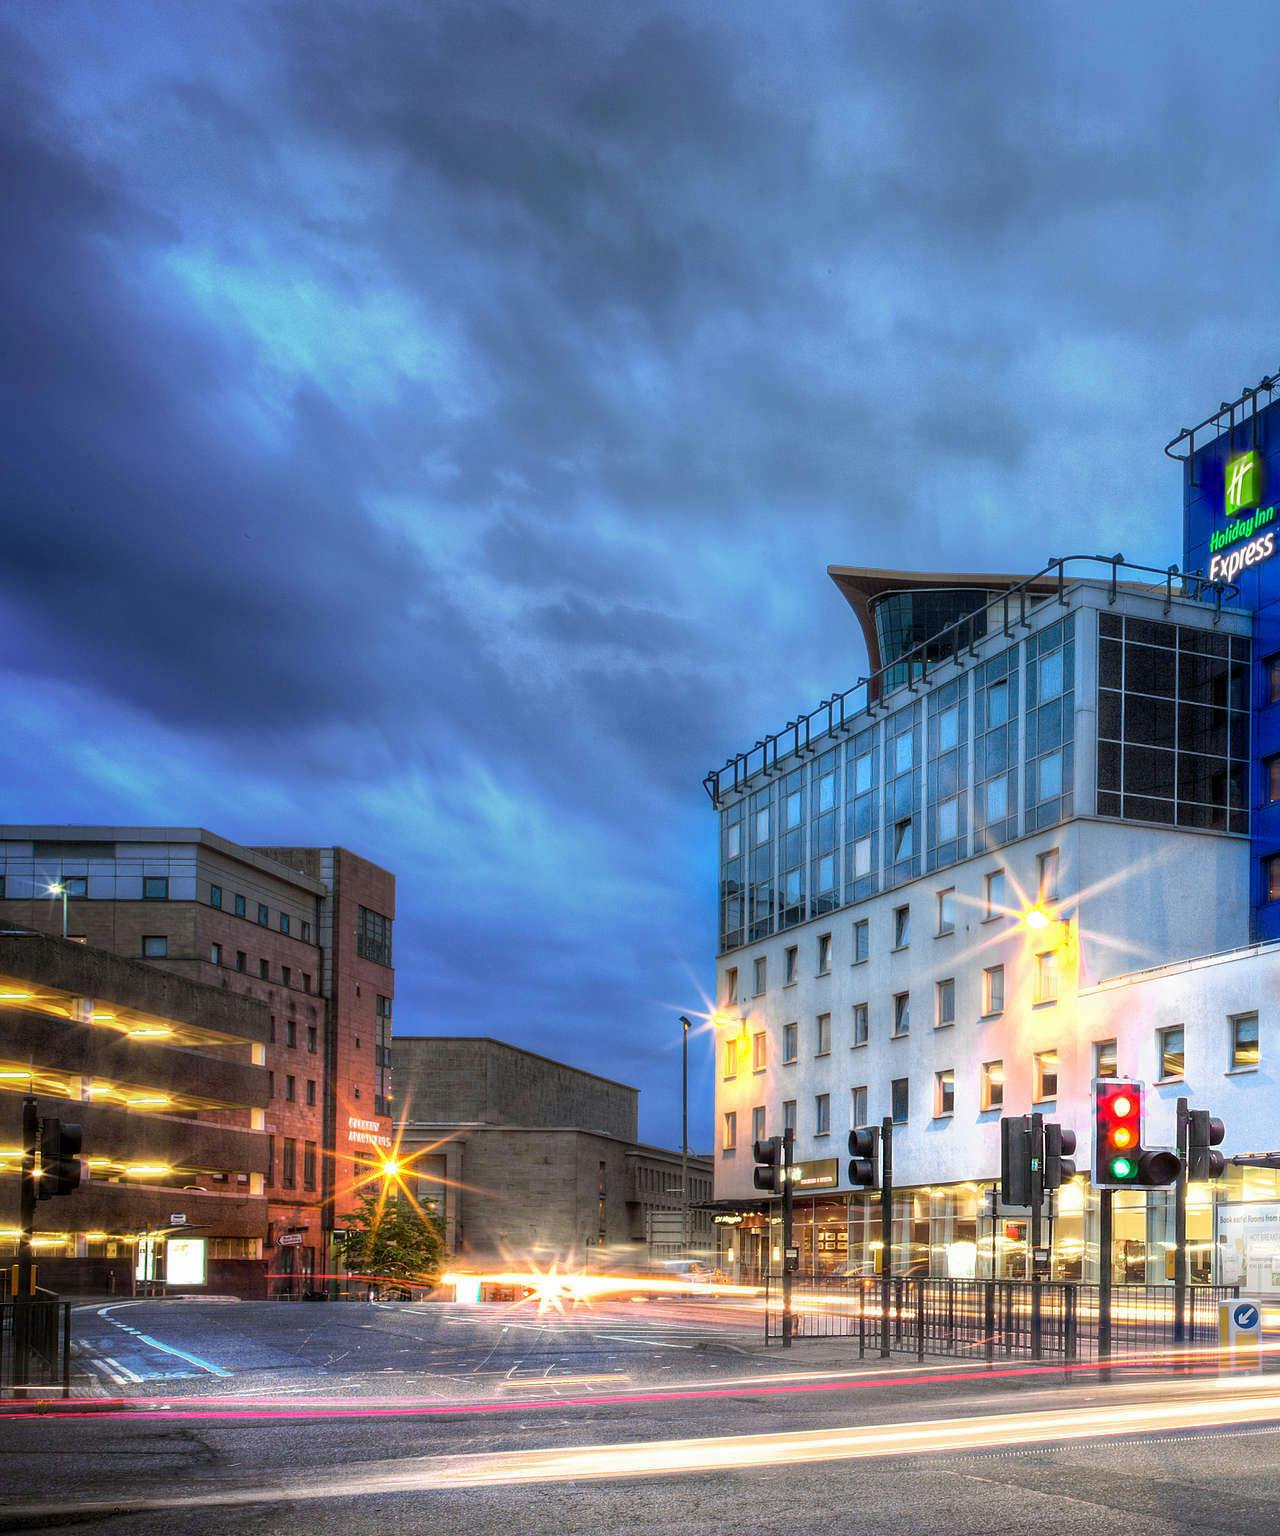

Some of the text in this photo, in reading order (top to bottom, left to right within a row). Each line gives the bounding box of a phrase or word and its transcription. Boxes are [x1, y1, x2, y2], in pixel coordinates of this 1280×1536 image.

[1210, 506, 1274, 552] Holiday Inn
[1209, 532, 1274, 582] Express
